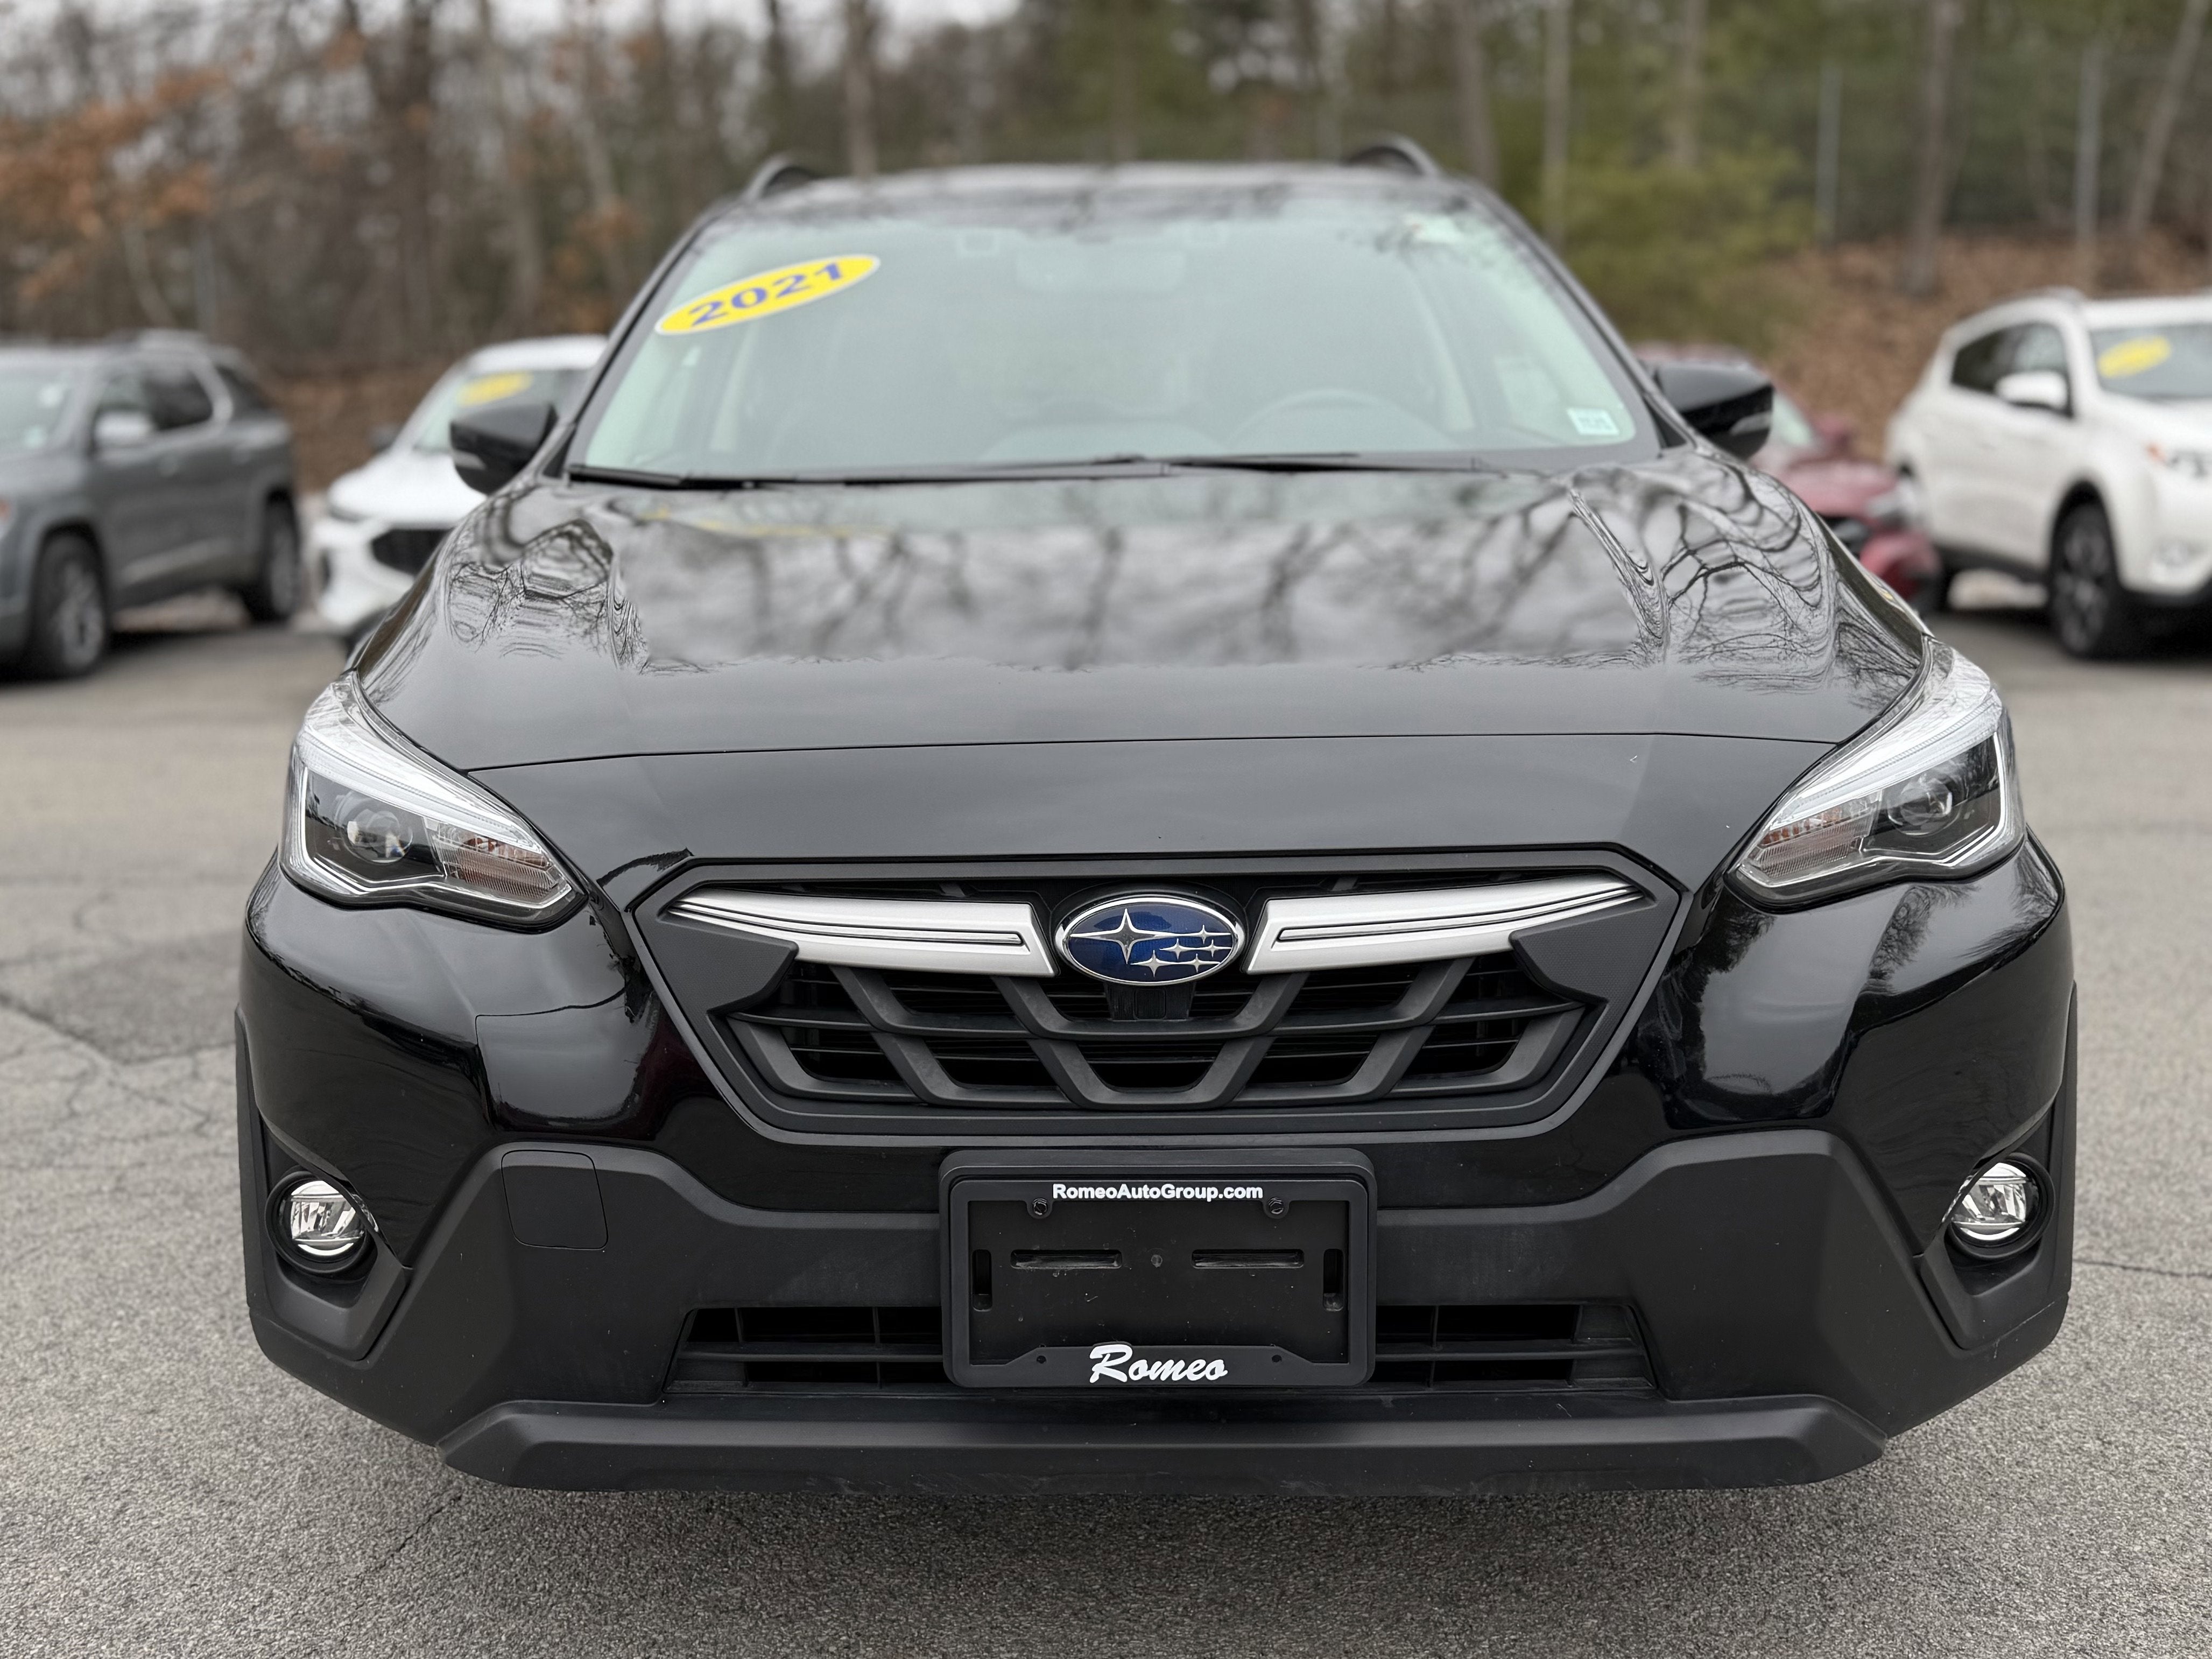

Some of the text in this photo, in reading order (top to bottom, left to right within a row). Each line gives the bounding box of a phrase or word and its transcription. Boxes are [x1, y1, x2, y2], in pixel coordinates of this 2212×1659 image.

[689, 262, 843, 327] 2021
[1052, 1184, 1263, 1201] RomeoAutoGroup.com
[1089, 1344, 1228, 1383] Romeo
